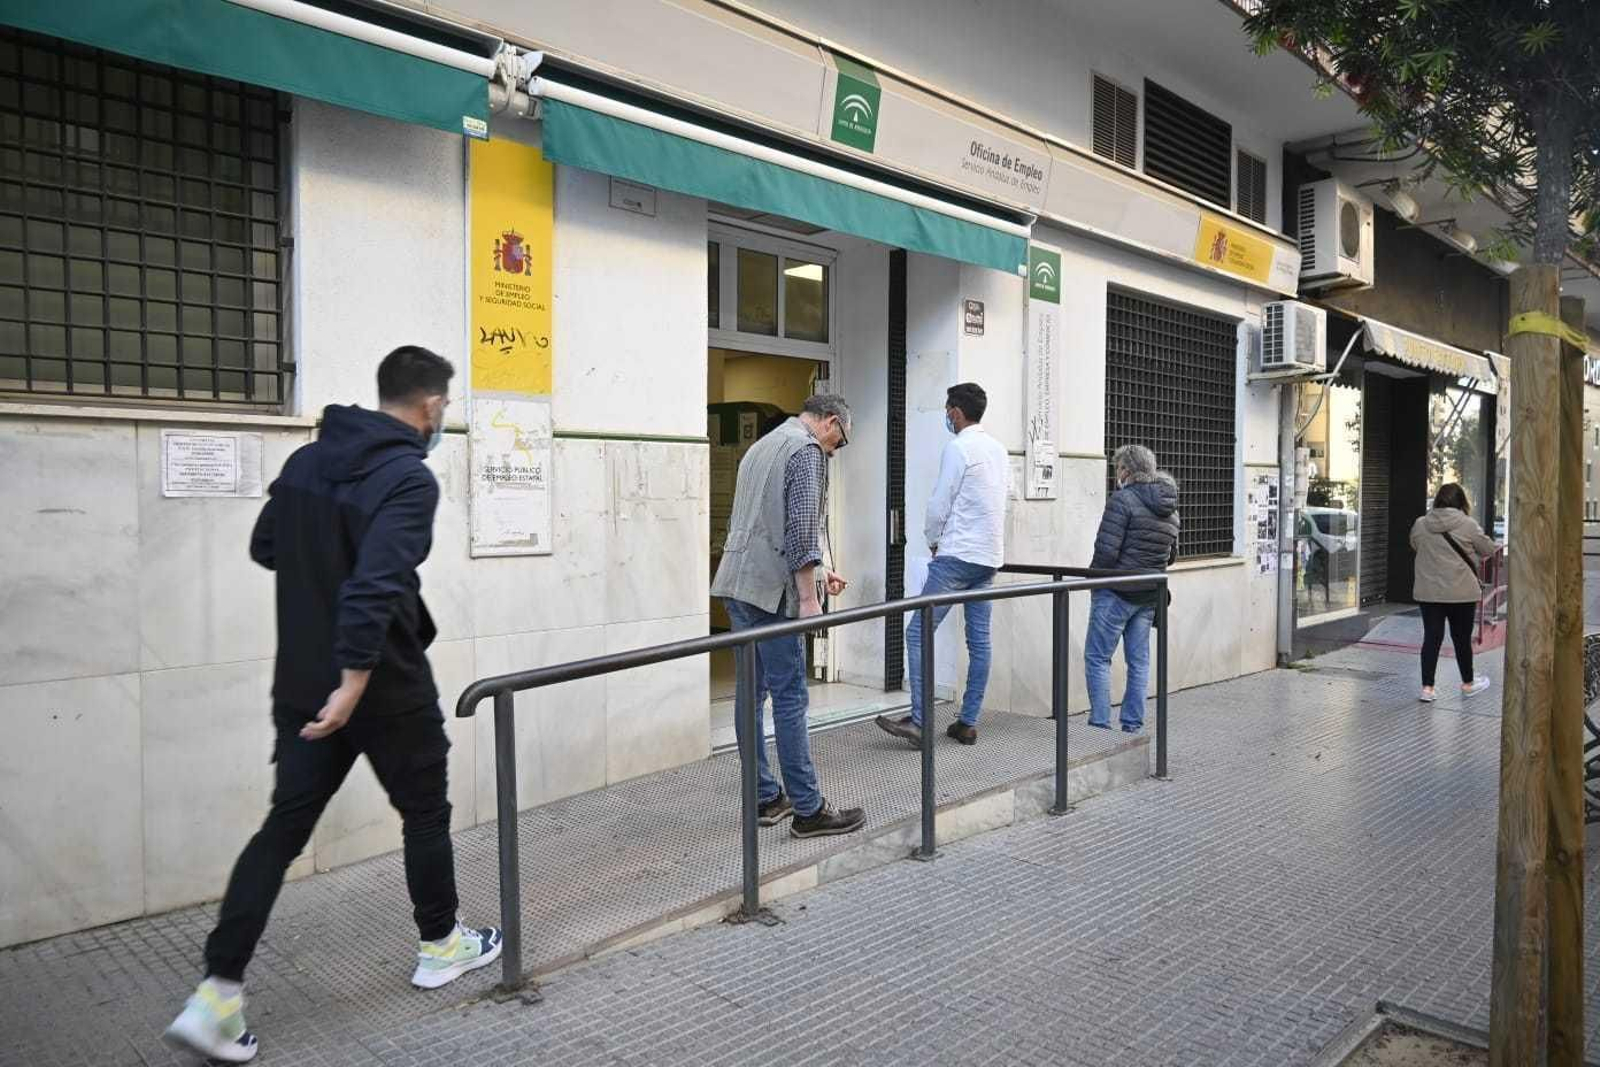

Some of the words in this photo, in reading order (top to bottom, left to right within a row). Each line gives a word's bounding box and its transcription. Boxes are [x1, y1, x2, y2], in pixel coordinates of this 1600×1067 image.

[970, 140, 1001, 166] Oficina
[1001, 153, 1013, 170] de
[1013, 157, 1044, 182] Empleo
[494, 281, 531, 293] MINISTERIO
[495, 289, 505, 298] DE
[506, 291, 531, 301] EMPLEO
[485, 296, 523, 308] SEGURIDAD
[523, 301, 546, 311] SOCIAL
